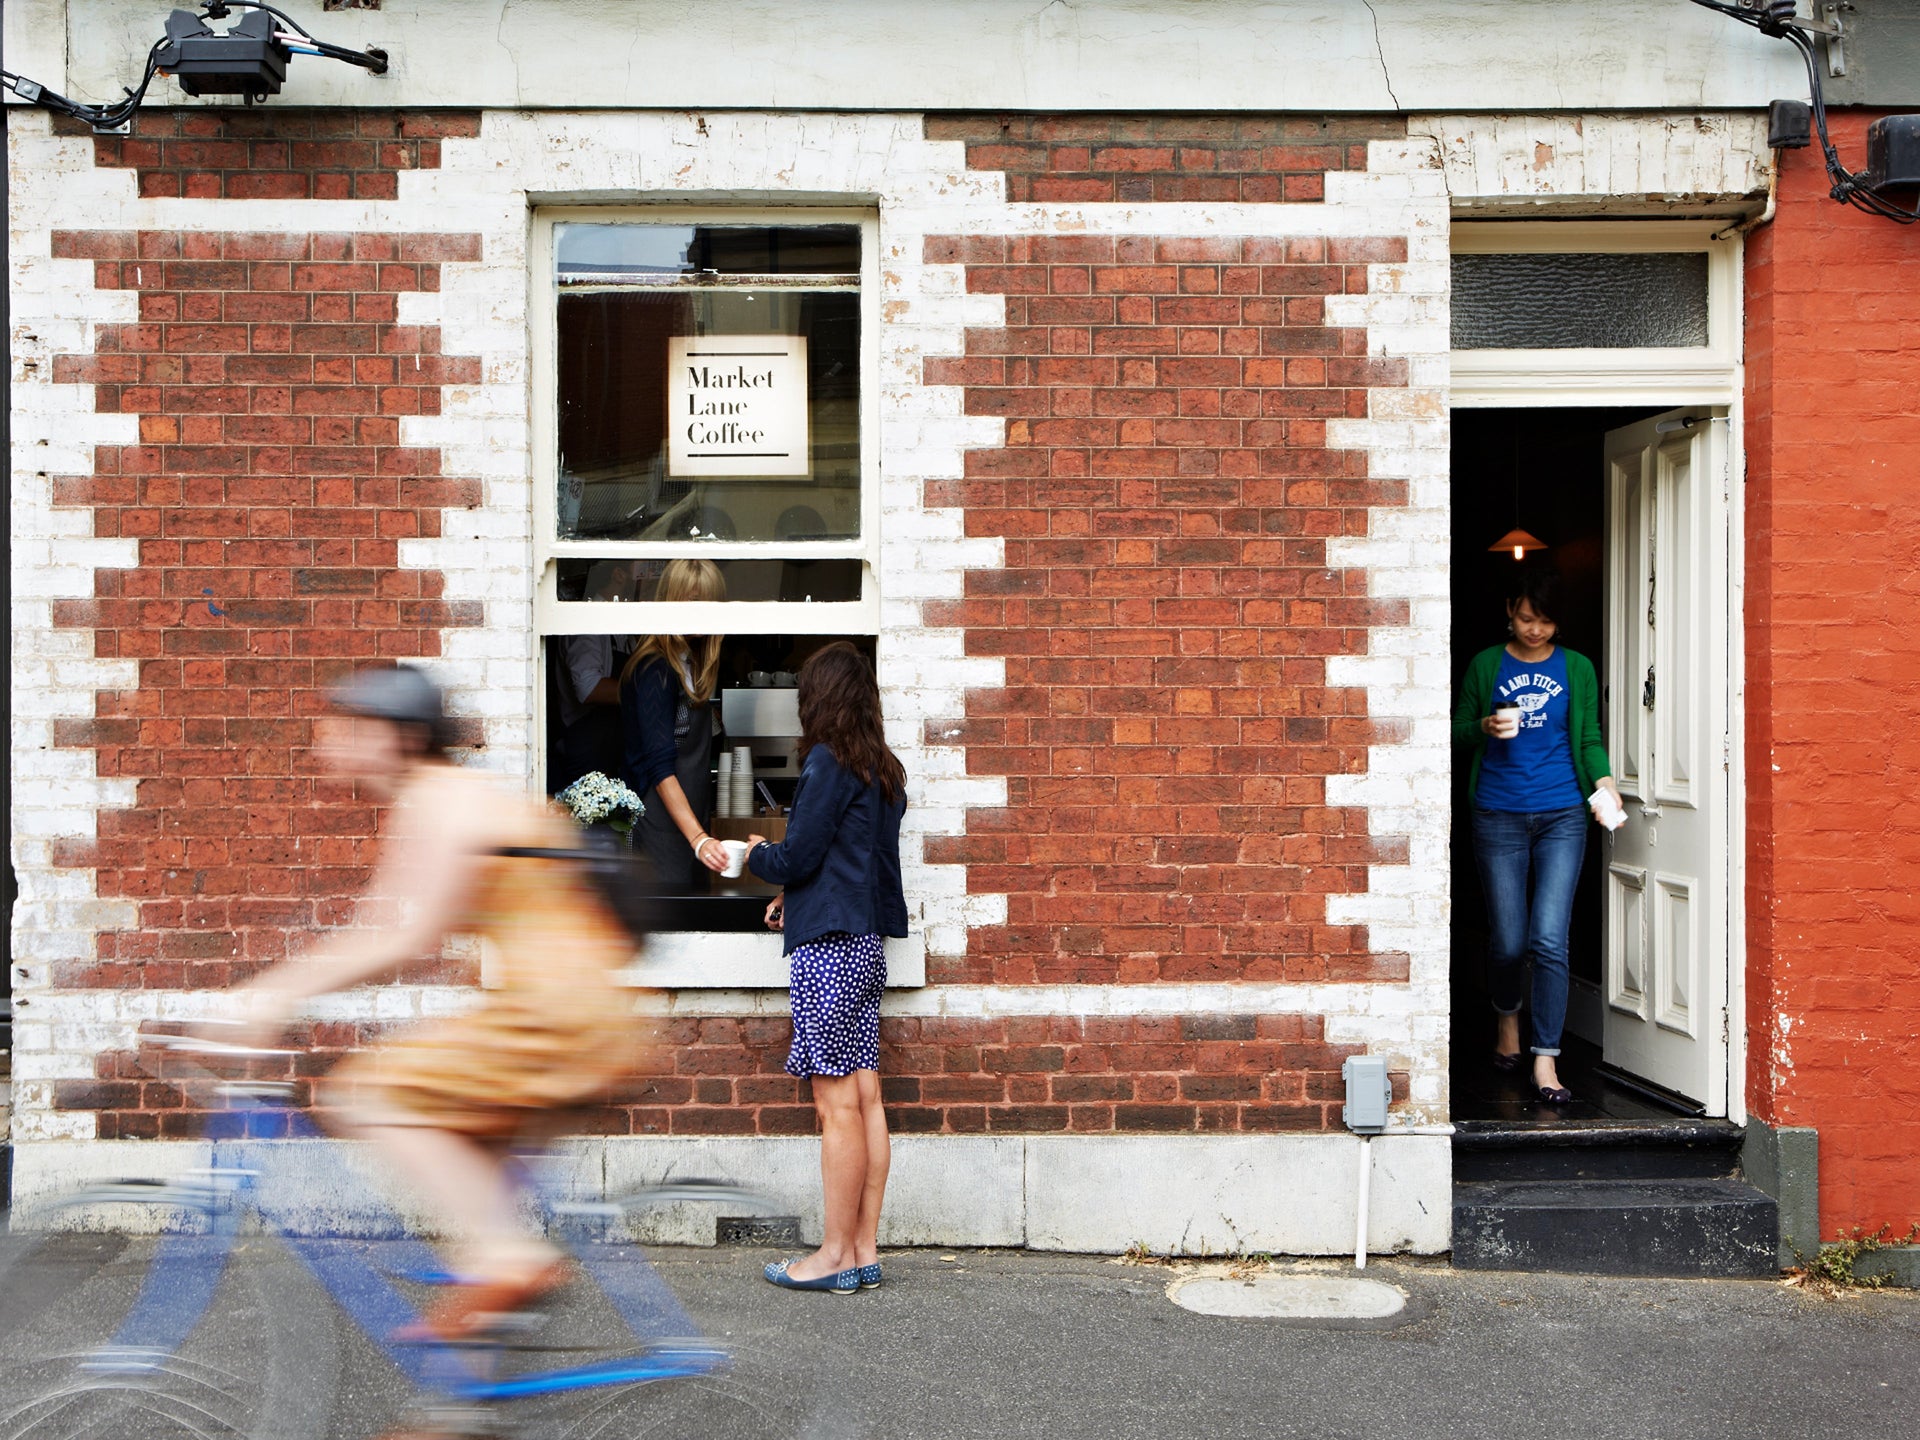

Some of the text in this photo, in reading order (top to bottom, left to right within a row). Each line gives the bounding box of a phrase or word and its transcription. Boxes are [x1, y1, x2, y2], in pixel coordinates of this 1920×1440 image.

[687, 366, 774, 388] Market
[688, 394, 748, 415] Lane
[687, 422, 764, 444] Coffee
[1499, 673, 1563, 697] A AND FITCH
